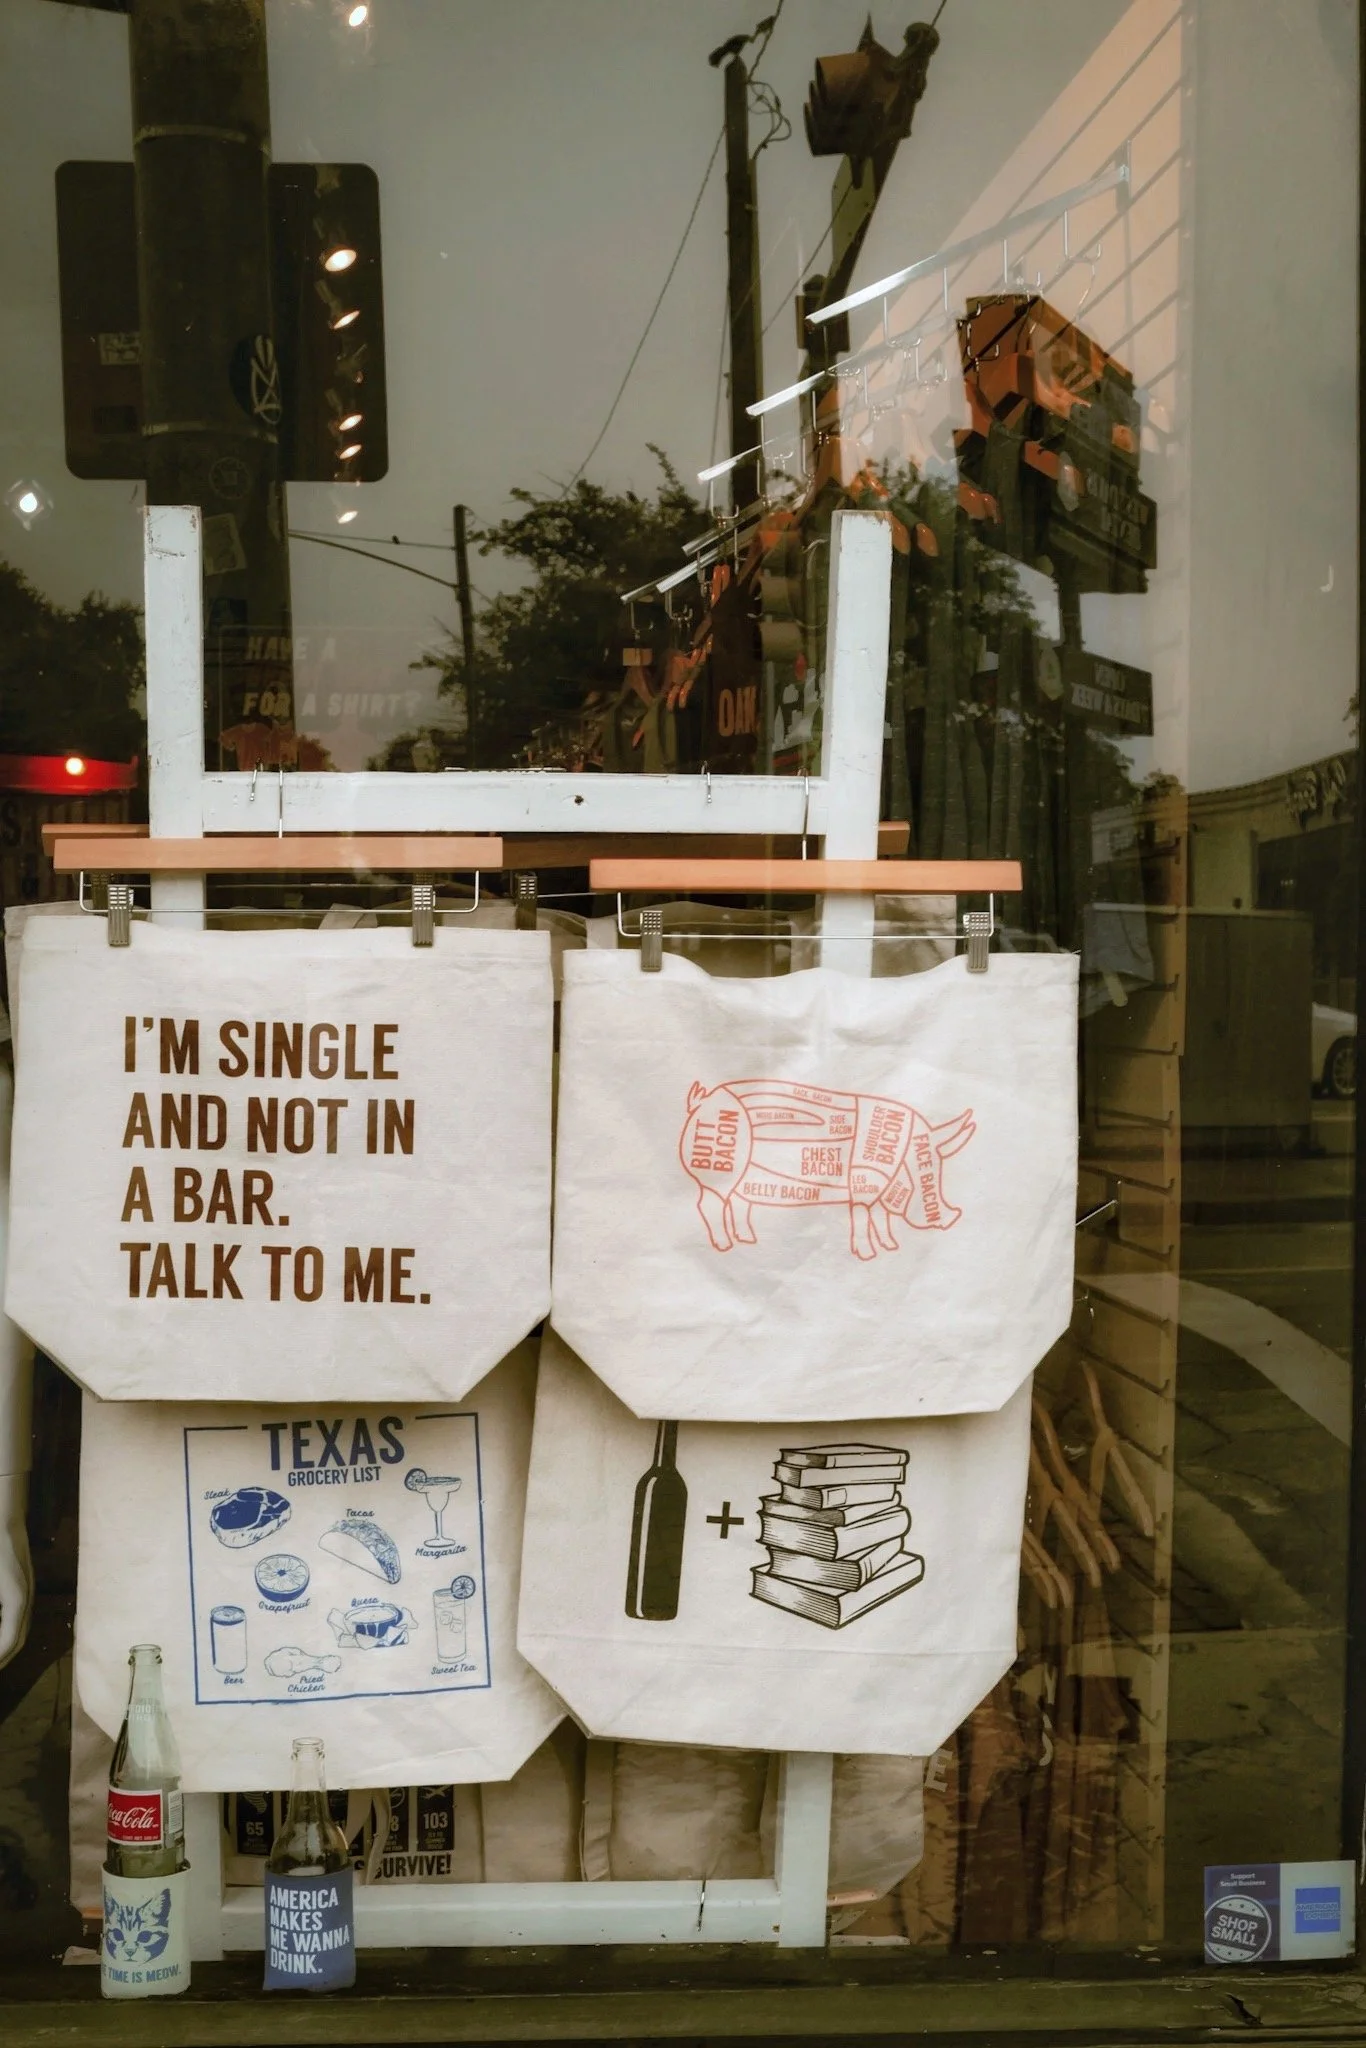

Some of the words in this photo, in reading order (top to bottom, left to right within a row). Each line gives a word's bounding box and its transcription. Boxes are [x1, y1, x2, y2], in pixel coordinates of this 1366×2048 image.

[124, 1016, 199, 1075] I'M
[219, 1020, 399, 1079] SINGLE
[122, 1092, 227, 1150] AND
[247, 1096, 348, 1154] NOT
[366, 1098, 415, 1154] IN
[829, 1115, 846, 1124] SIDE
[829, 1125, 852, 1135] BACON
[862, 1105, 886, 1162] SHOULDER
[876, 1110, 905, 1165] BACON
[691, 1119, 714, 1169] BUTT
[713, 1109, 739, 1172] BACON
[801, 1147, 842, 1162] CHEST
[913, 1133, 933, 1171] FACE
[801, 1162, 843, 1177] BACON
[121, 1166, 154, 1222] A
[174, 1167, 289, 1226] BAR.
[743, 1183, 777, 1197] BELLY
[780, 1187, 821, 1201] BACON
[852, 1184, 879, 1194] BACON
[920, 1173, 941, 1223] BACON
[120, 1242, 244, 1300] TALK
[261, 1245, 324, 1302] TO
[343, 1246, 431, 1304] ME.
[261, 1416, 405, 1471] TEXAS
[287, 1468, 348, 1487] GROCERY
[353, 1466, 382, 1483] LIST
[203, 1489, 231, 1501] Steak
[345, 1508, 374, 1518] Tacos
[415, 1545, 467, 1560] Margarita
[258, 1598, 311, 1614] Grapefruit
[431, 1664, 458, 1676] Sweet
[459, 1663, 477, 1673] Tea
[223, 1674, 245, 1685] Beer
[299, 1674, 325, 1684] Fried
[287, 1683, 326, 1694] Chicken
[246, 1821, 265, 1837] 65
[423, 1812, 448, 1829] 103
[1220, 1880, 1238, 1888] Small
[1238, 1879, 1267, 1887] Business
[1230, 1873, 1256, 1882] Support
[269, 1885, 339, 1910] AMERICA
[270, 1906, 323, 1932] MAKES
[1218, 1914, 1258, 1932] SHOP
[270, 1929, 289, 1951] ME
[293, 1925, 351, 1953] WANNA
[1211, 1925, 1258, 1947] SMALL
[270, 1952, 324, 1974] DRINK.
[108, 1966, 129, 1984] TIME
[132, 1971, 143, 1984] IS
[146, 1963, 182, 1983] MEOW.
